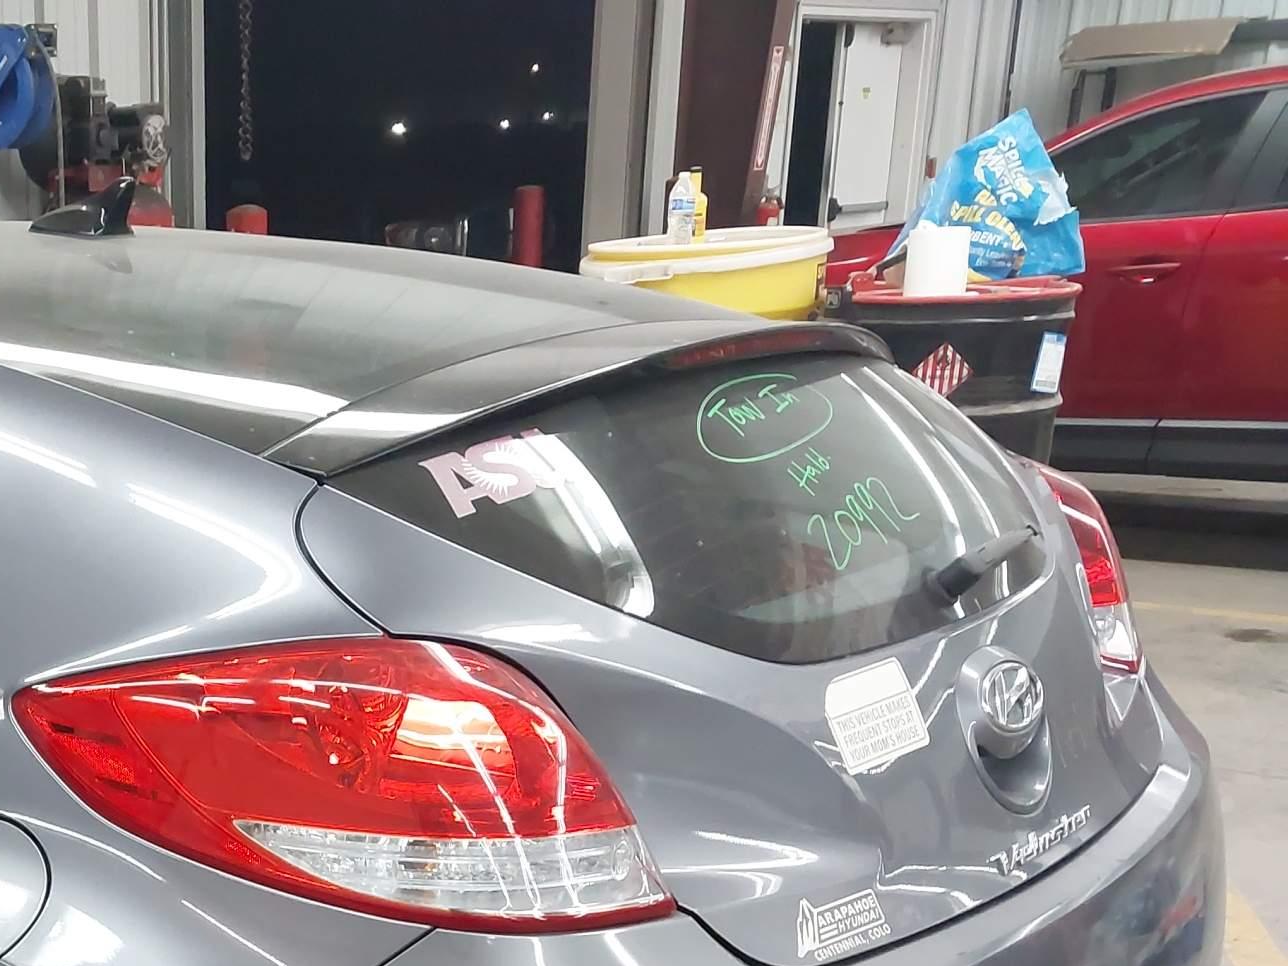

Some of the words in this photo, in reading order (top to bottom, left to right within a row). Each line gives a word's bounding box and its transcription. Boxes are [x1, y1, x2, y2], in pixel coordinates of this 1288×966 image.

[707, 398, 765, 437] Tow
[758, 384, 800, 413] In
[807, 477, 920, 570] 20992
[836, 717, 856, 733] THIS
[854, 704, 887, 727] VEHICLE
[886, 695, 912, 712] MAKES
[843, 722, 882, 749] FREQUENT
[881, 715, 906, 732] STOPS
[904, 710, 916, 724] AT
[849, 744, 871, 762] YOUR
[895, 725, 920, 744] HOUSE
[817, 895, 877, 928] ARAPAHOE
[838, 907, 880, 934] HYUNDAI
[868, 922, 891, 941] COLO
